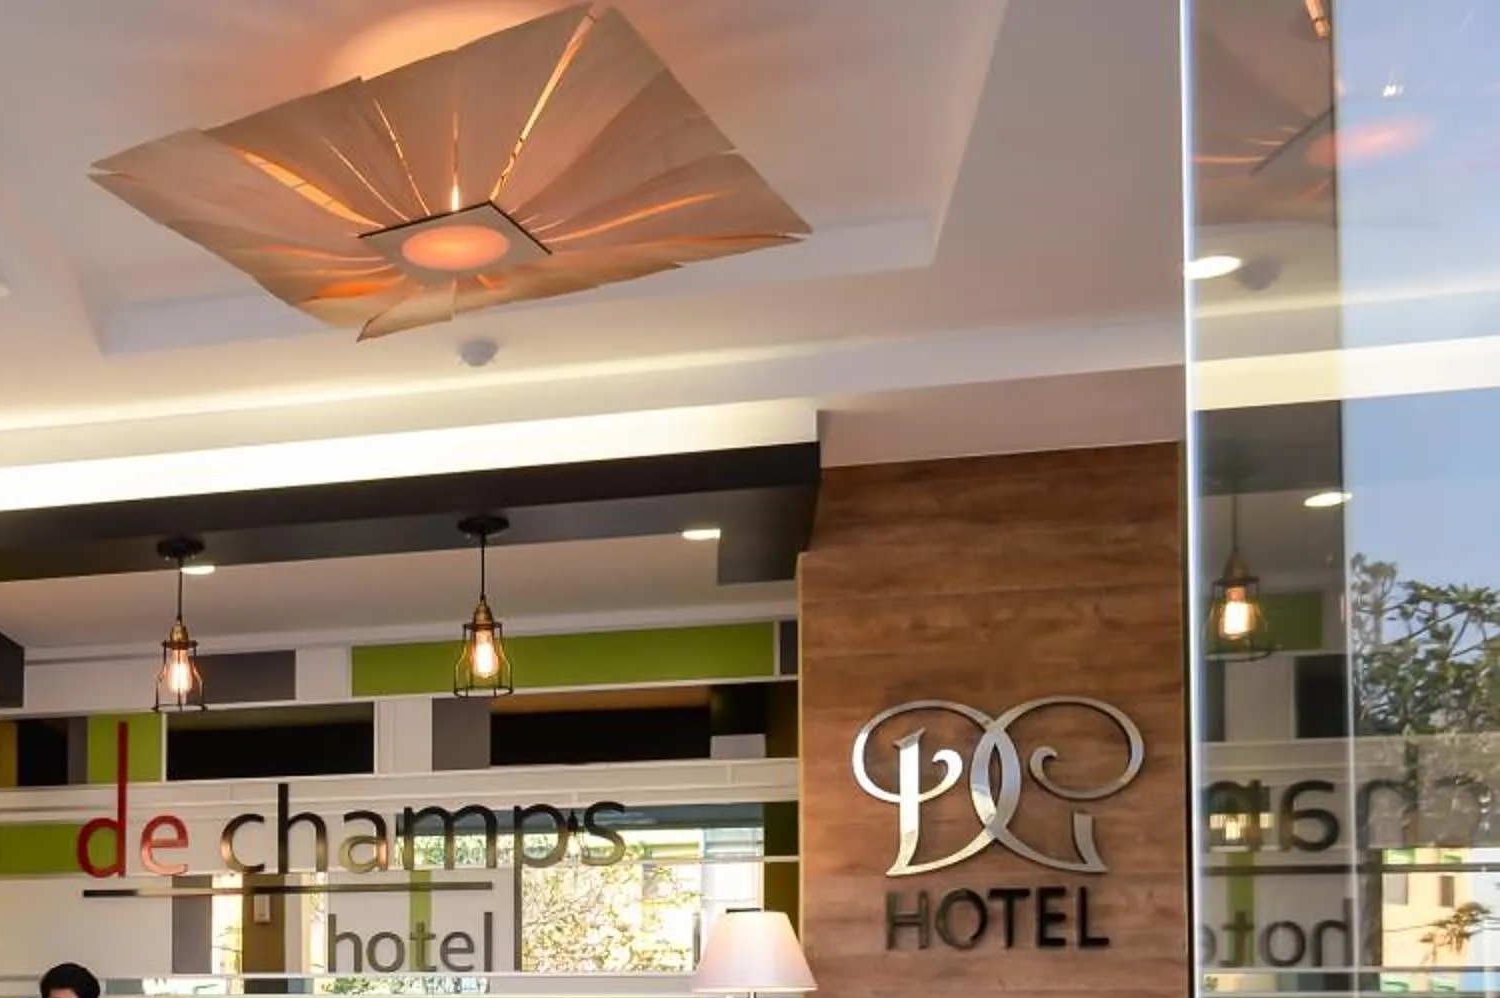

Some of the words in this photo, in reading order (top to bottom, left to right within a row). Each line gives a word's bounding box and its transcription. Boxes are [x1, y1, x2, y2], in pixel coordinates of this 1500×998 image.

[76, 721, 190, 878] de
[219, 783, 627, 973] champs
[328, 911, 493, 974] hotel
[885, 885, 1111, 951] HOTEL
